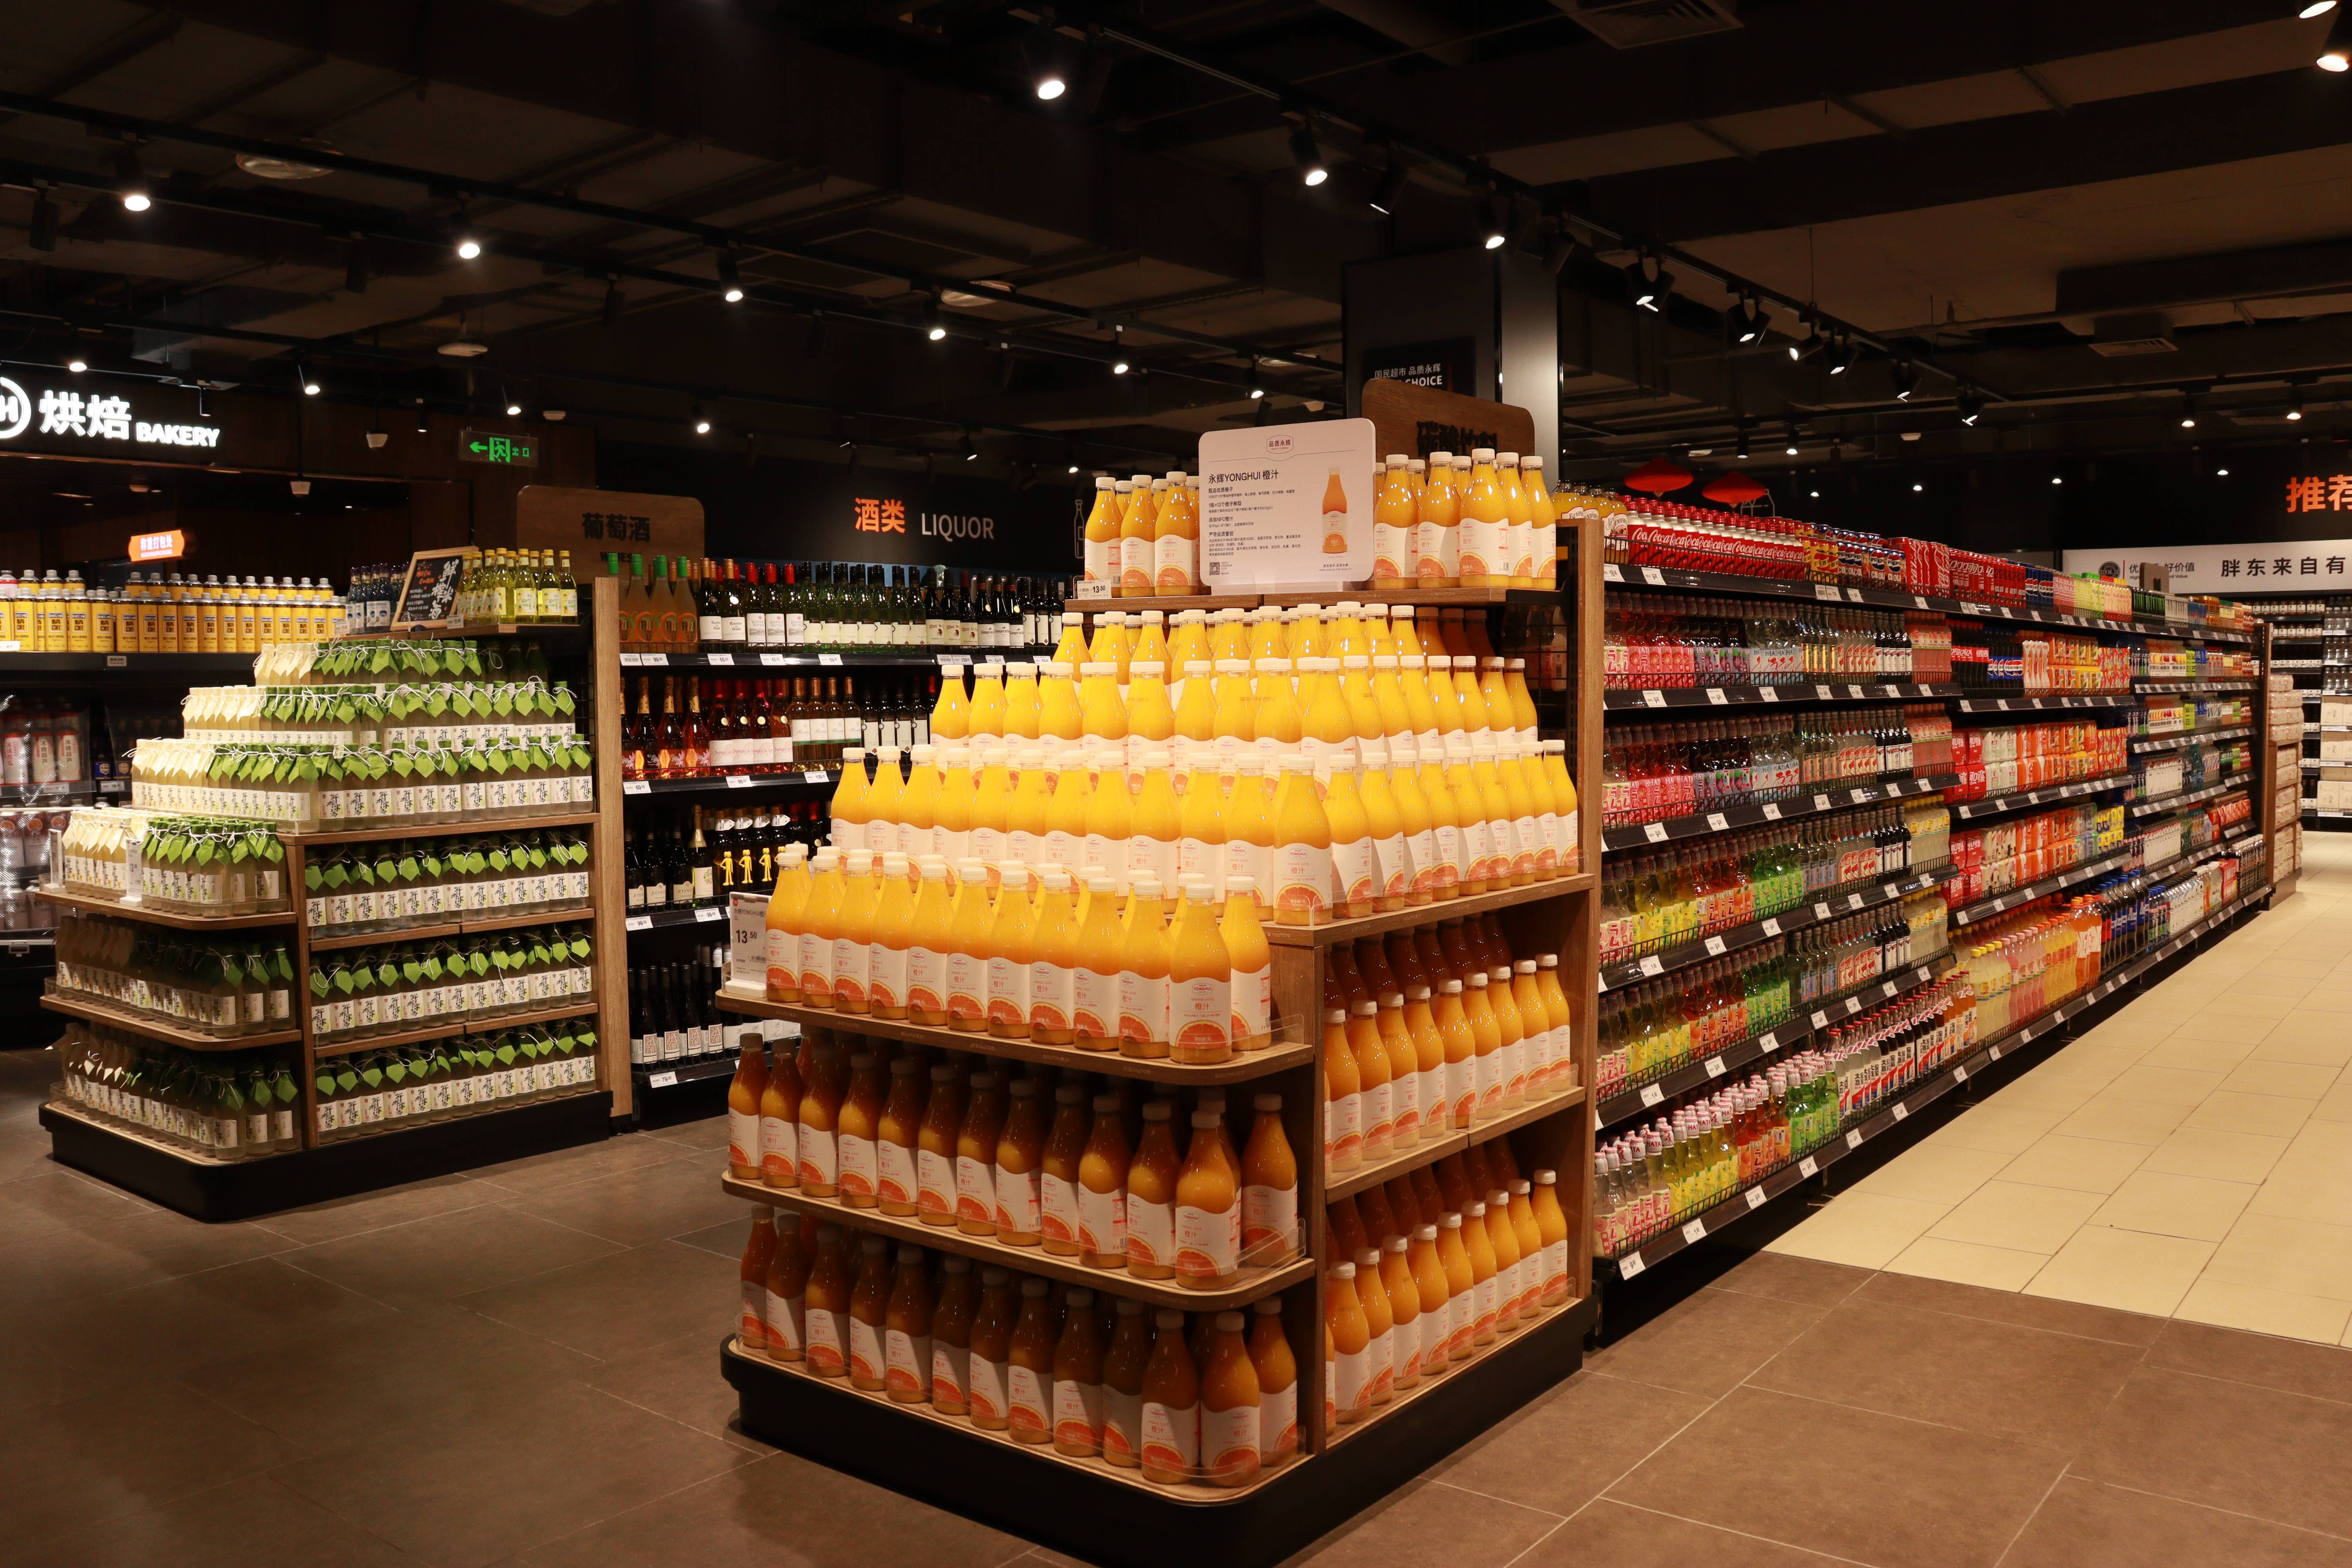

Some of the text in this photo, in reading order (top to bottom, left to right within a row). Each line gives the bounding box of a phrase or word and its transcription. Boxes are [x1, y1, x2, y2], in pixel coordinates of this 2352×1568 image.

[1375, 363, 1441, 379] 国民超市 品质永辉
[39, 390, 220, 447] 烘焙 BAKERY
[1269, 439, 1291, 447] 品质永辉
[1208, 469, 1279, 484] 永辉YONGHUI 橙汁
[582, 512, 651, 542] 葡萄酒
[855, 497, 994, 542] 酒类 LIQUOR
[1443, 847, 1455, 855] 橙汁
[735, 929, 757, 944] 13.50
